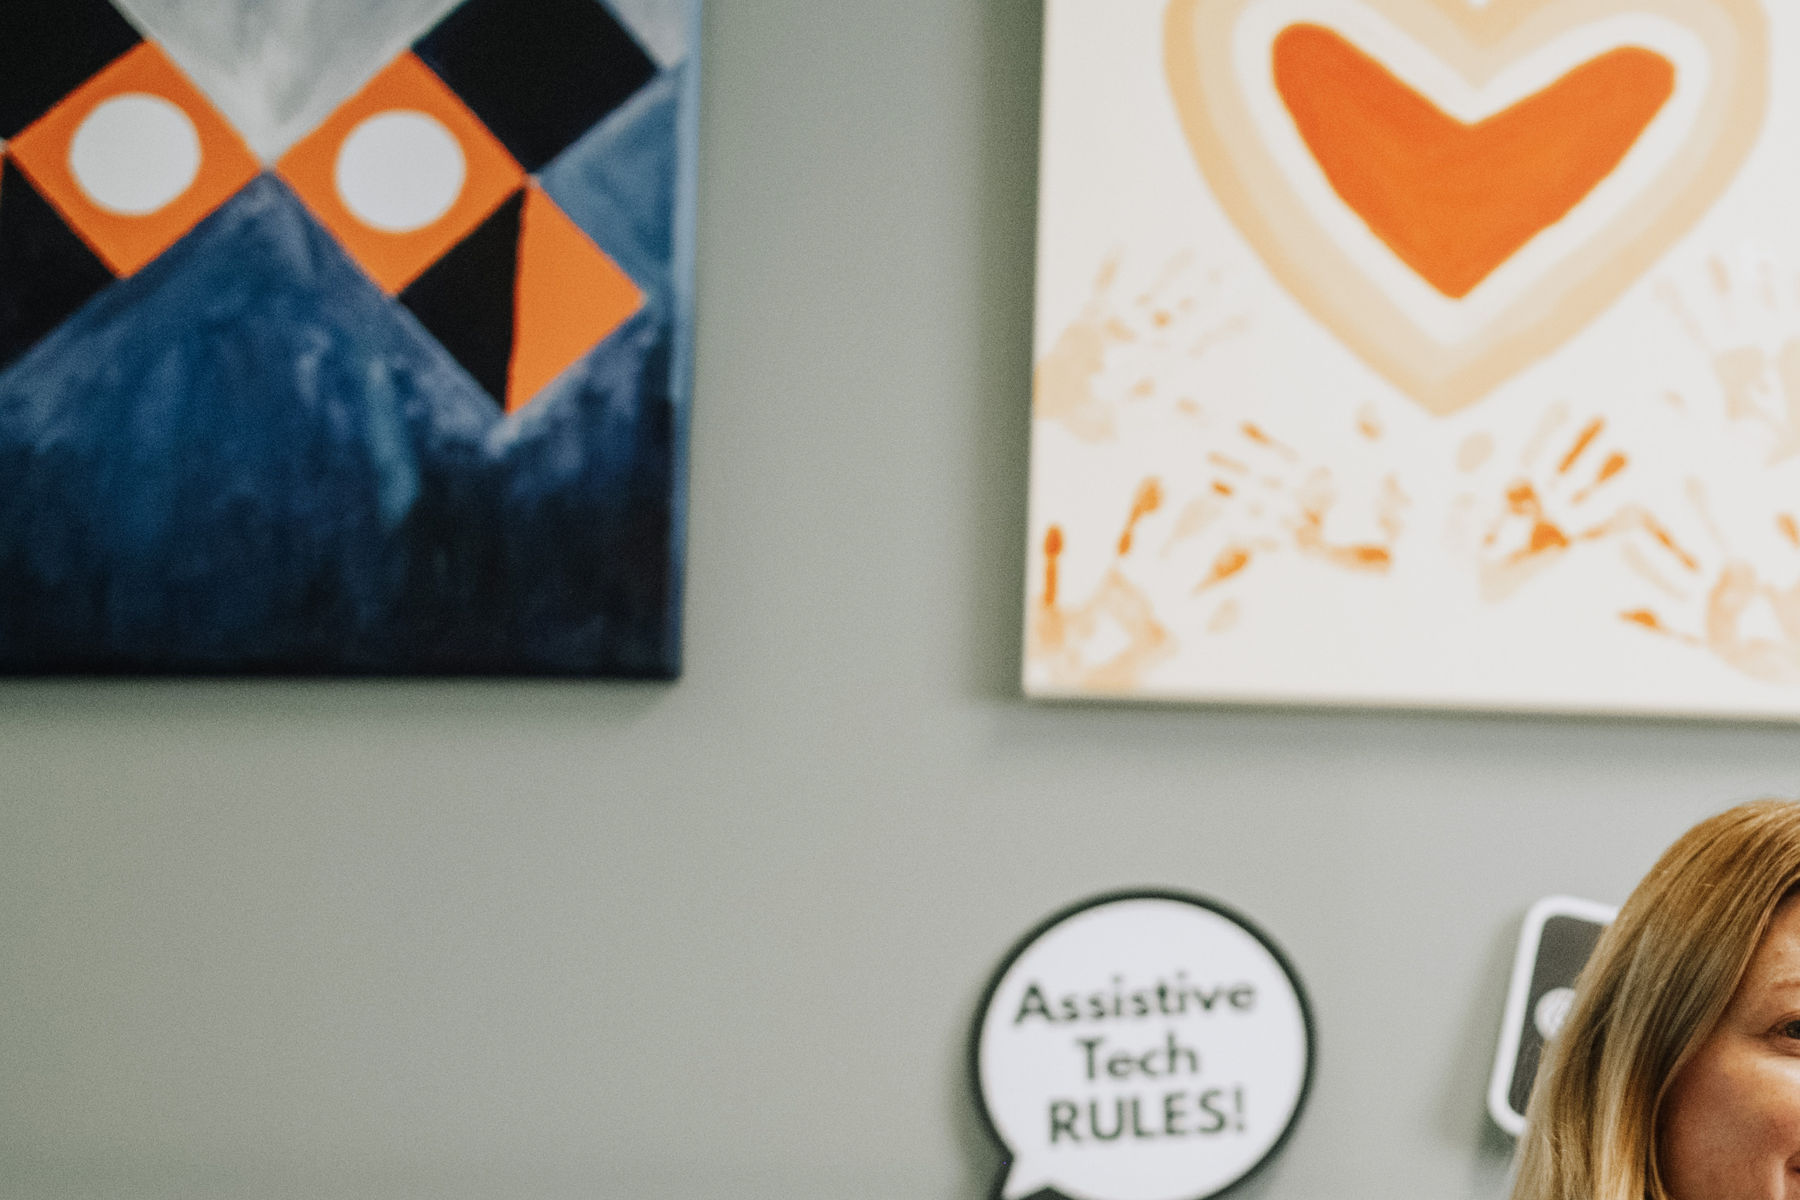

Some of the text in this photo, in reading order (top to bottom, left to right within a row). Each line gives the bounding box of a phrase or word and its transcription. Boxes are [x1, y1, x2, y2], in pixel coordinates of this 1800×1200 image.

[1012, 970, 1256, 1026] Assistive
[1076, 1032, 1197, 1080] Tech
[1049, 1085, 1246, 1143] RULES!
